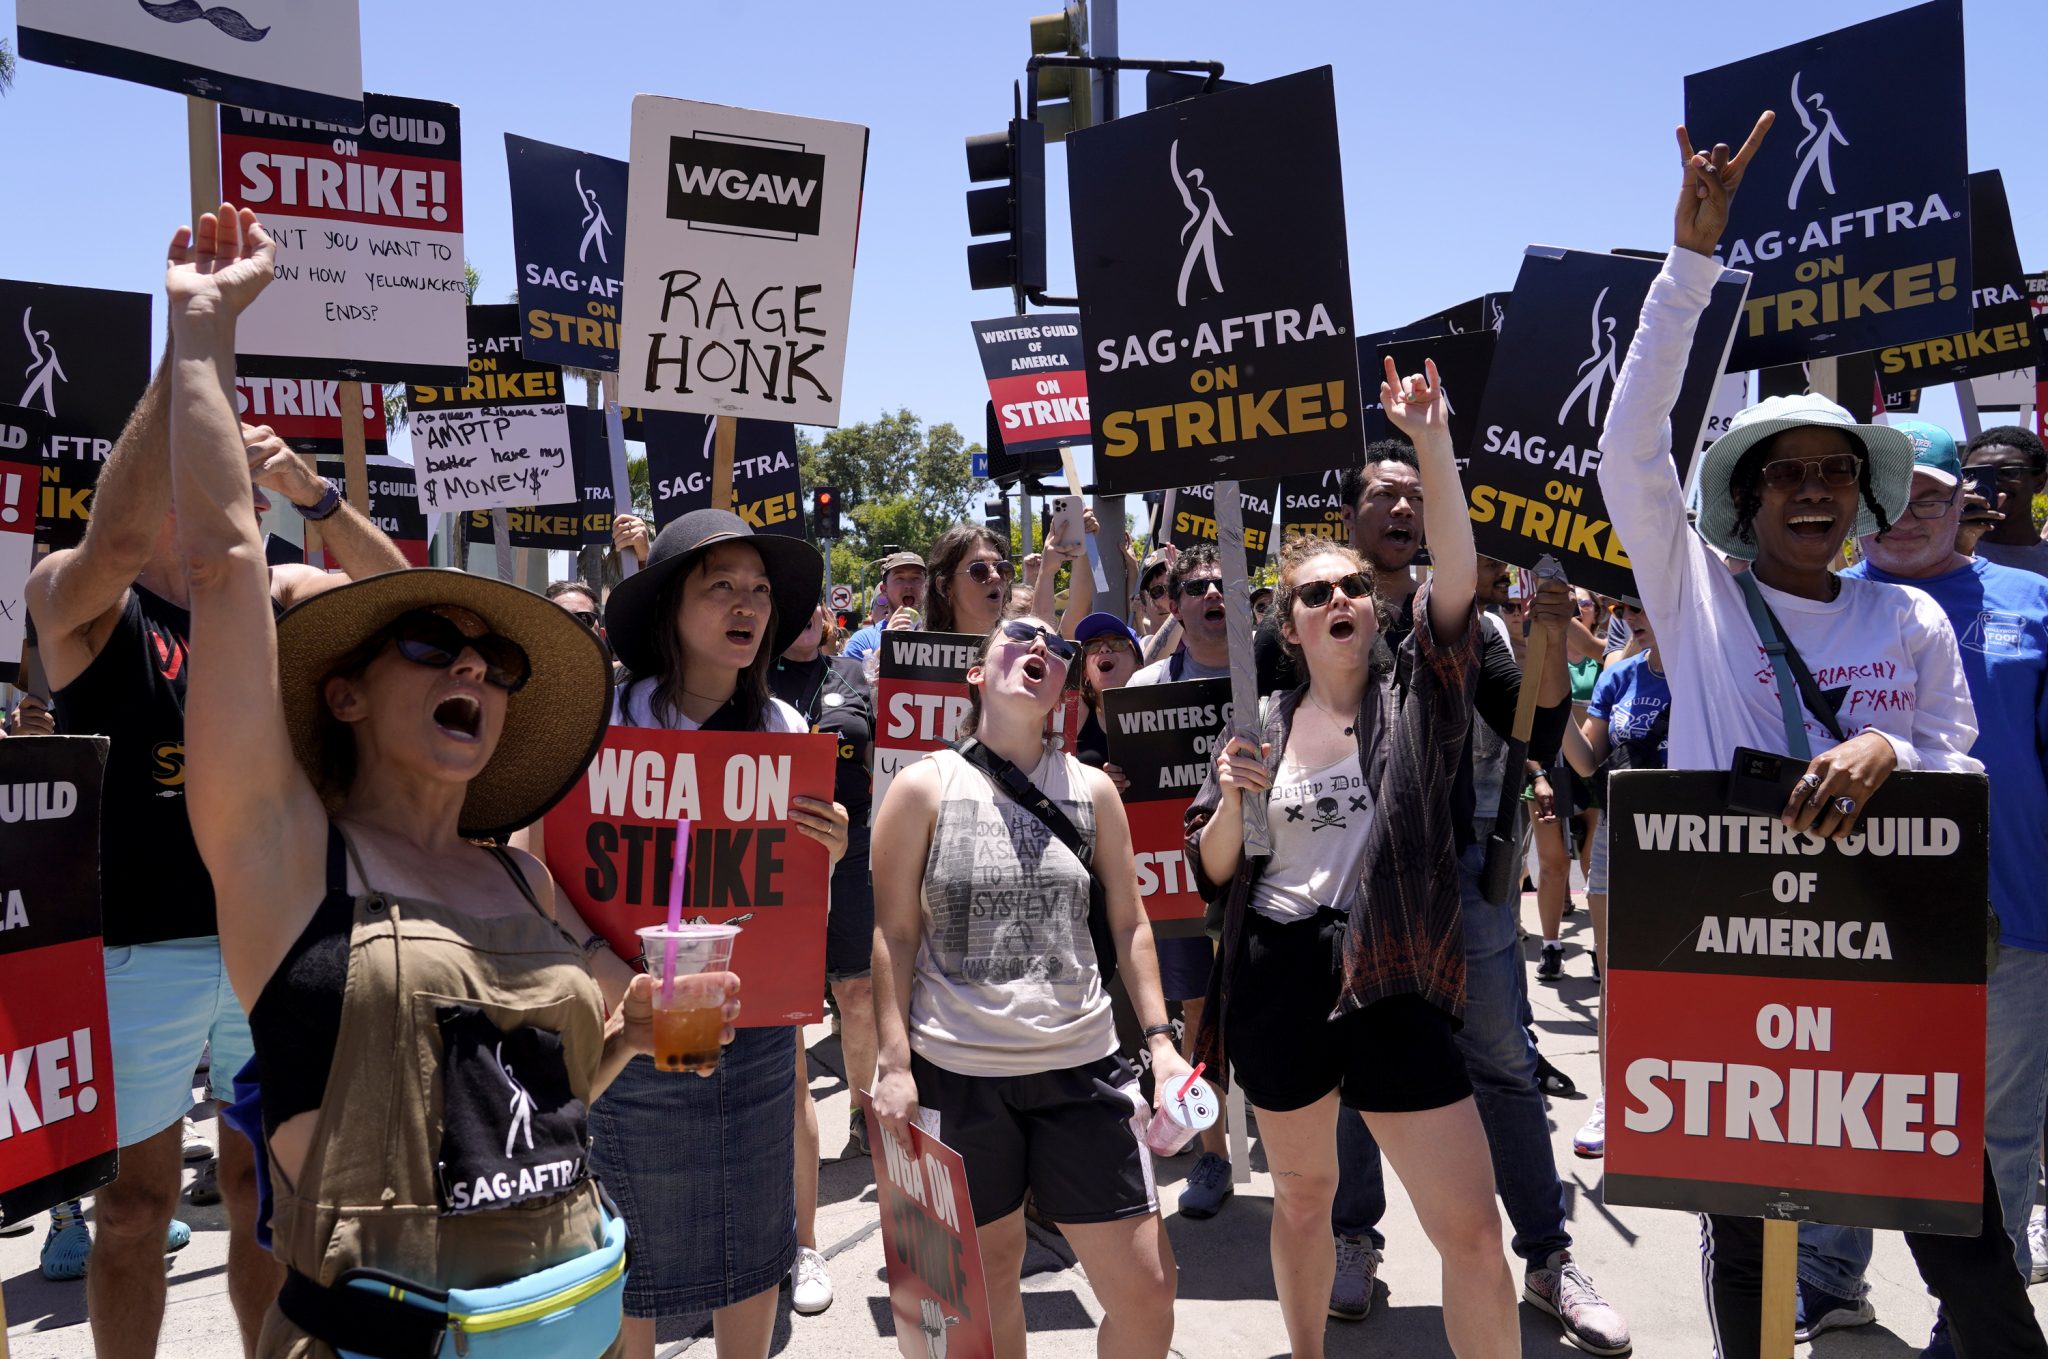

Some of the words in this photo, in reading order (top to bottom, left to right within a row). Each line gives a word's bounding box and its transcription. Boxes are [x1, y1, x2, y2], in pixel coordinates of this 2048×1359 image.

[369, 113, 445, 146] GUILD
[332, 138, 358, 157] ON
[240, 151, 448, 223] STRIKE!
[675, 163, 818, 208] WGAW
[324, 231, 358, 251] YOU
[369, 238, 420, 257] WANT
[428, 243, 451, 261] TO
[309, 267, 346, 284] HOW
[1795, 255, 1844, 282] ON
[325, 302, 378, 322] ENDS?
[586, 301, 616, 319] ON
[659, 269, 827, 338] RAGE
[981, 326, 1041, 344] WRITERS
[1042, 325, 1078, 338] GUILD
[1028, 342, 1042, 352] OF
[1880, 322, 2031, 374] STRIKE!
[469, 358, 497, 372] ON
[645, 331, 833, 405] HONK
[1011, 354, 1069, 371] AMERICA
[1036, 380, 1061, 395] ON
[1190, 364, 1238, 394] ON
[1102, 379, 1348, 458] STRIKE!
[426, 455, 477, 474] better
[491, 448, 530, 463] have
[540, 448, 565, 468] my
[380, 481, 418, 497] GUILD
[1544, 480, 1583, 507] ON
[471, 510, 578, 536] SRIKE!
[1118, 704, 1218, 735] WRITERS
[588, 747, 701, 821] WGA
[723, 754, 791, 822] ON
[1633, 813, 1826, 856] WRITERS
[1836, 817, 1960, 857] GUILD
[584, 821, 786, 908] STRIKE
[1772, 871, 1818, 903] OF
[1695, 916, 1893, 961] AMERICA
[1756, 1003, 1832, 1052] ON
[1624, 1057, 1961, 1157] STRIKE!
[926, 1152, 960, 1234] ON
